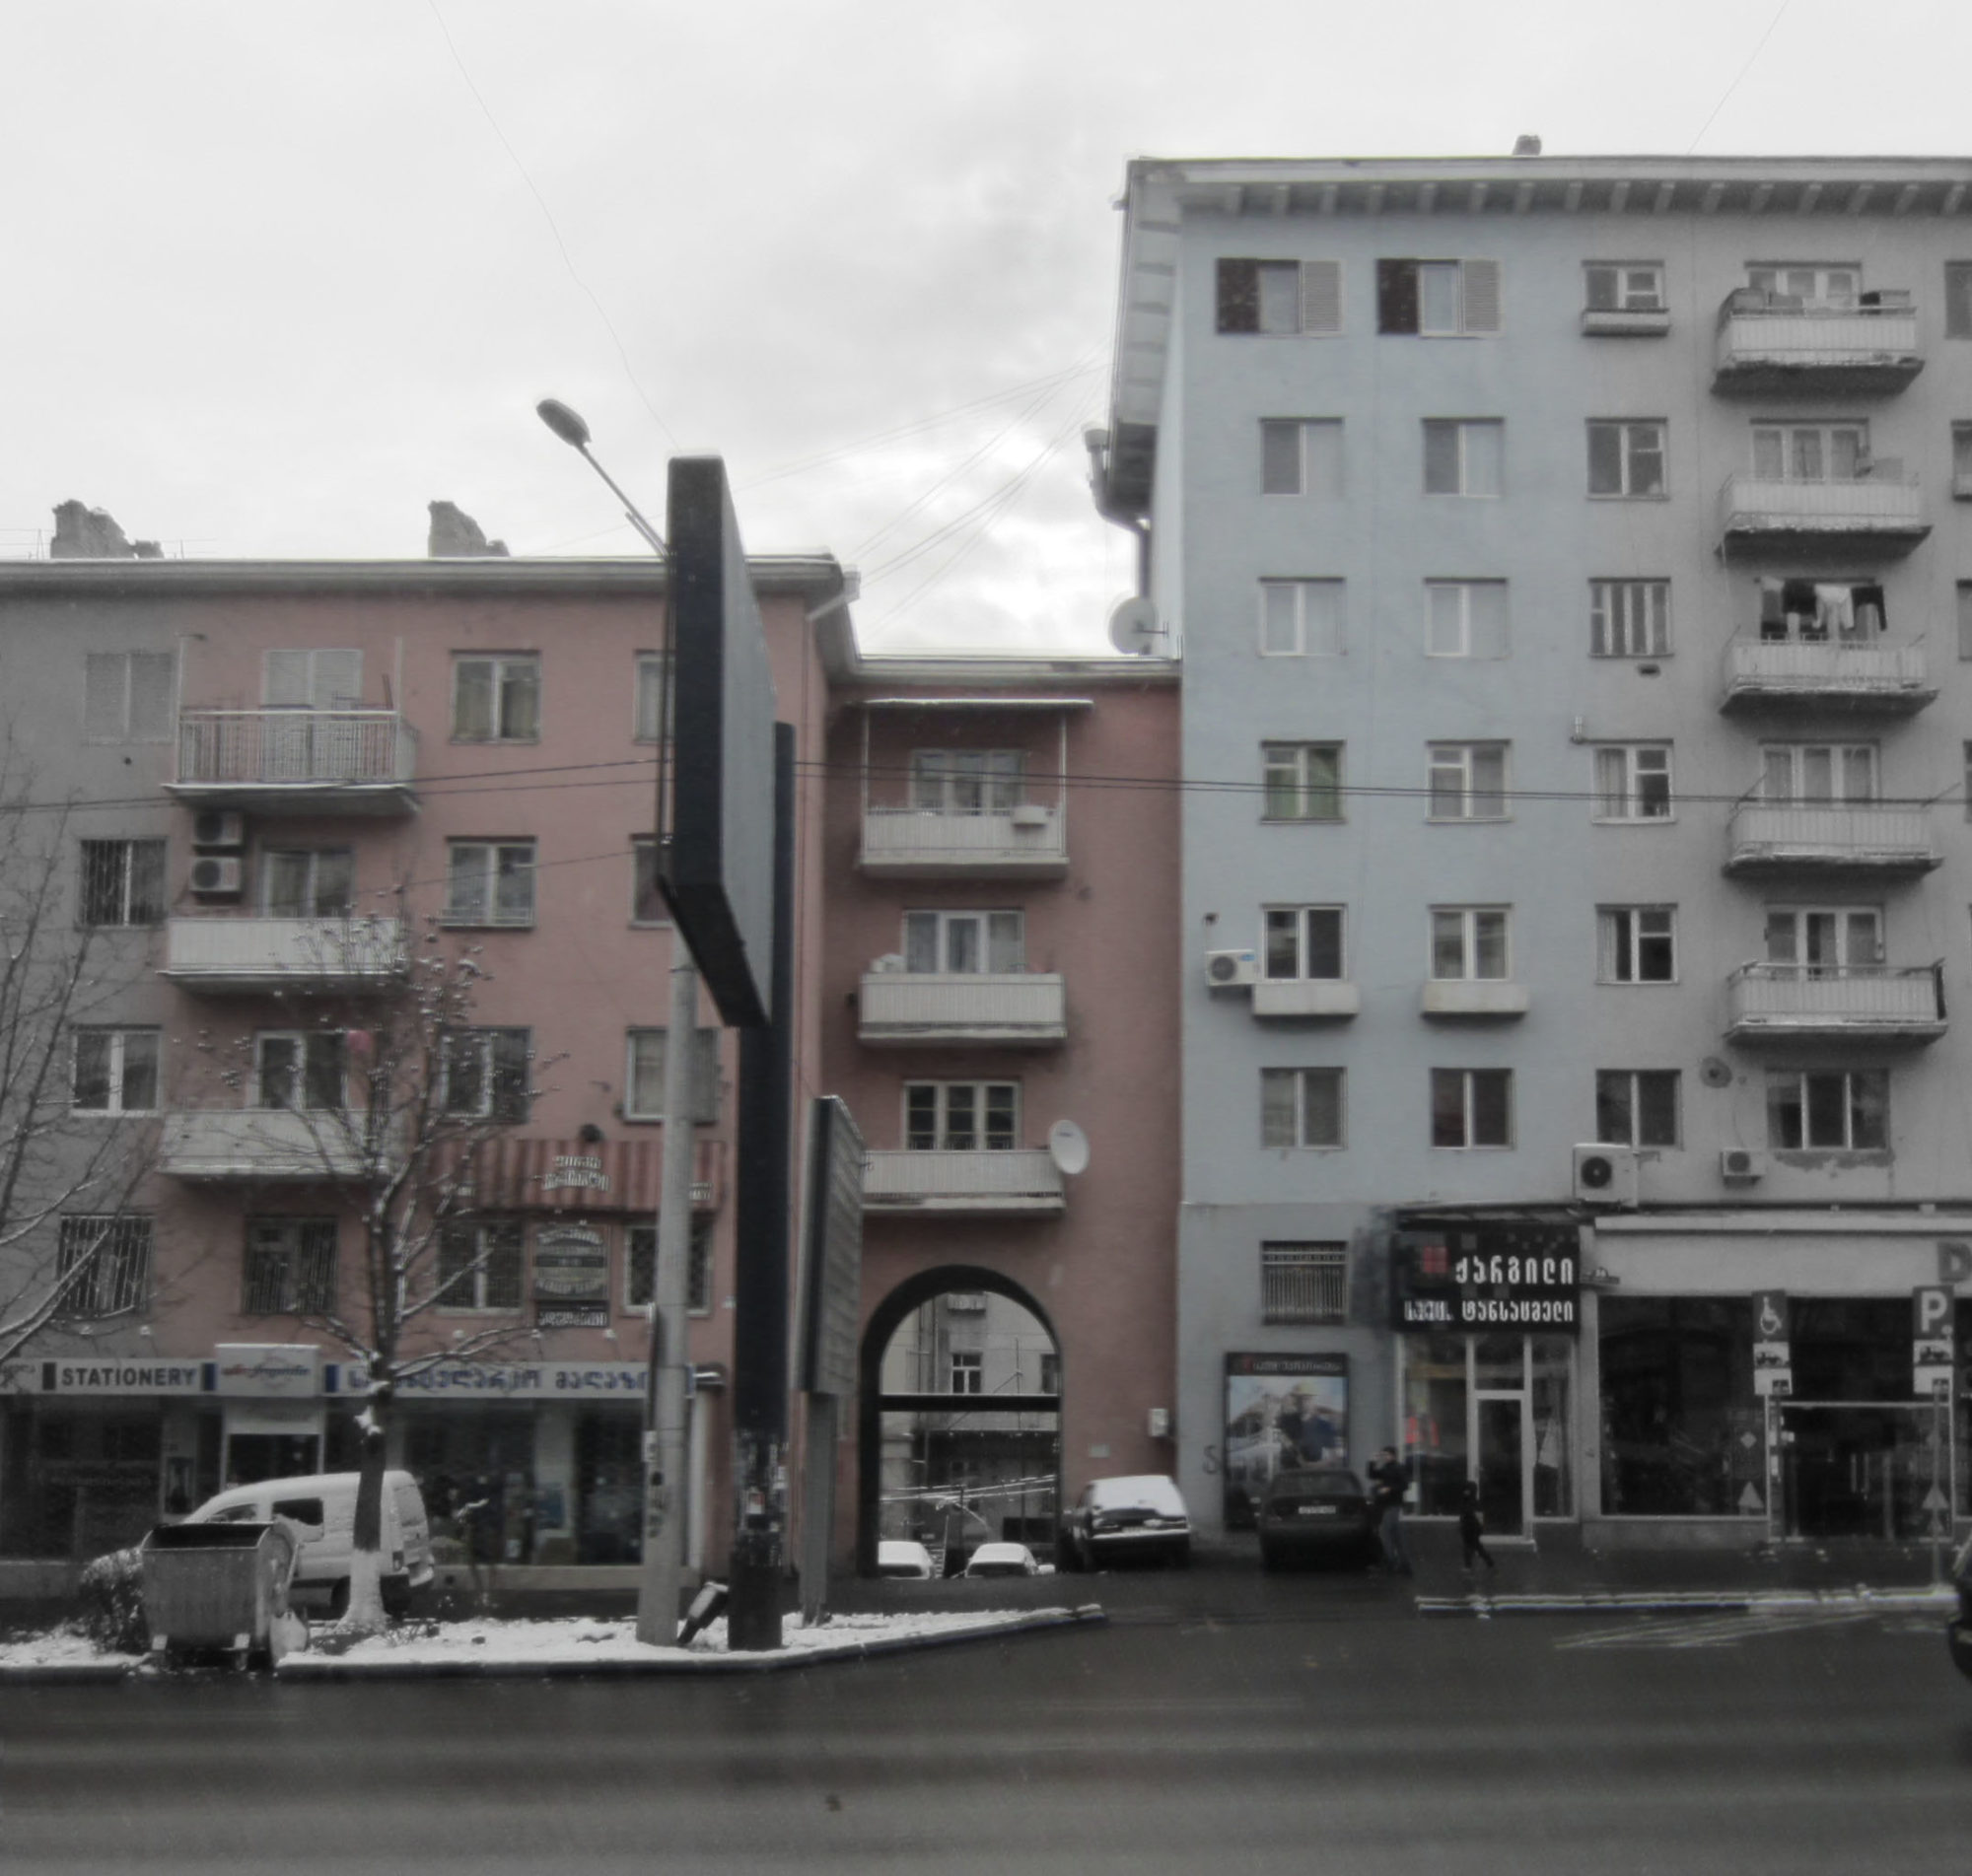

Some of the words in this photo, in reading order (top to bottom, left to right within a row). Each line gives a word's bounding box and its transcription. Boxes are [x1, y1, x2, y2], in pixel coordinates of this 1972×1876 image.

[1462, 1300, 1575, 1323] ტანსაცმელი
[1920, 1290, 1948, 1334] P
[61, 1367, 198, 1387] STATIONERY
